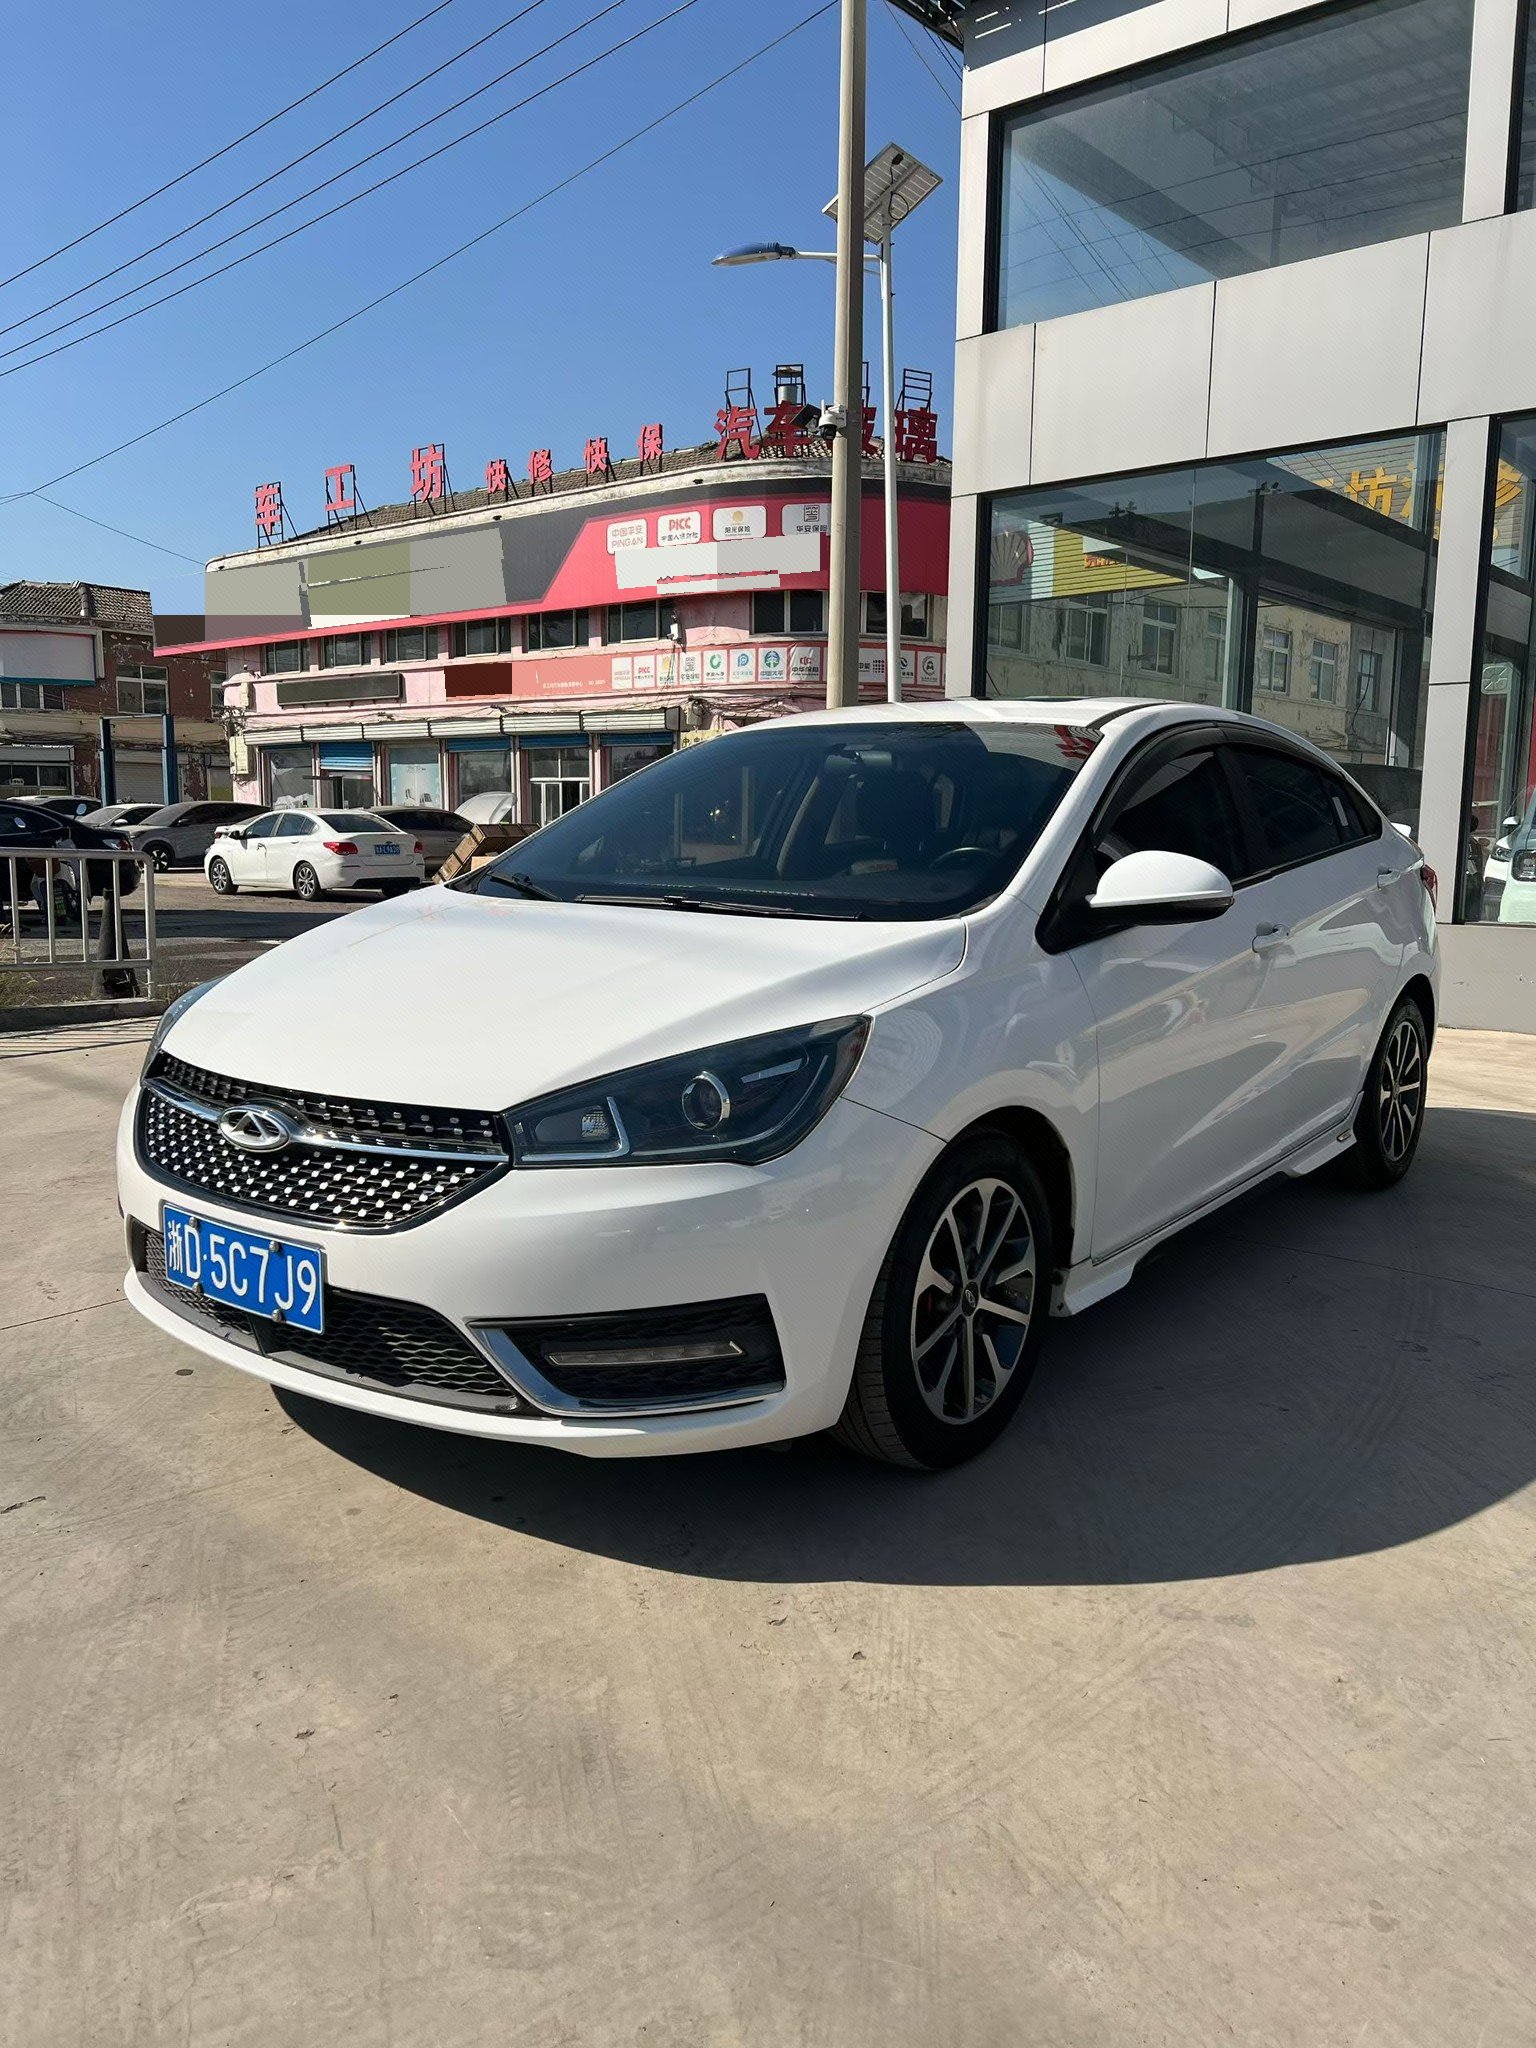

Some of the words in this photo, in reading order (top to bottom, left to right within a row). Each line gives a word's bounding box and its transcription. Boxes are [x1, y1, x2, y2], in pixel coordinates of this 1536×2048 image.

[485, 423, 663, 494] 快修快保
[611, 525, 643, 537] 中国平安
[668, 516, 691, 532] PICC
[724, 525, 751, 534] 阳光保险
